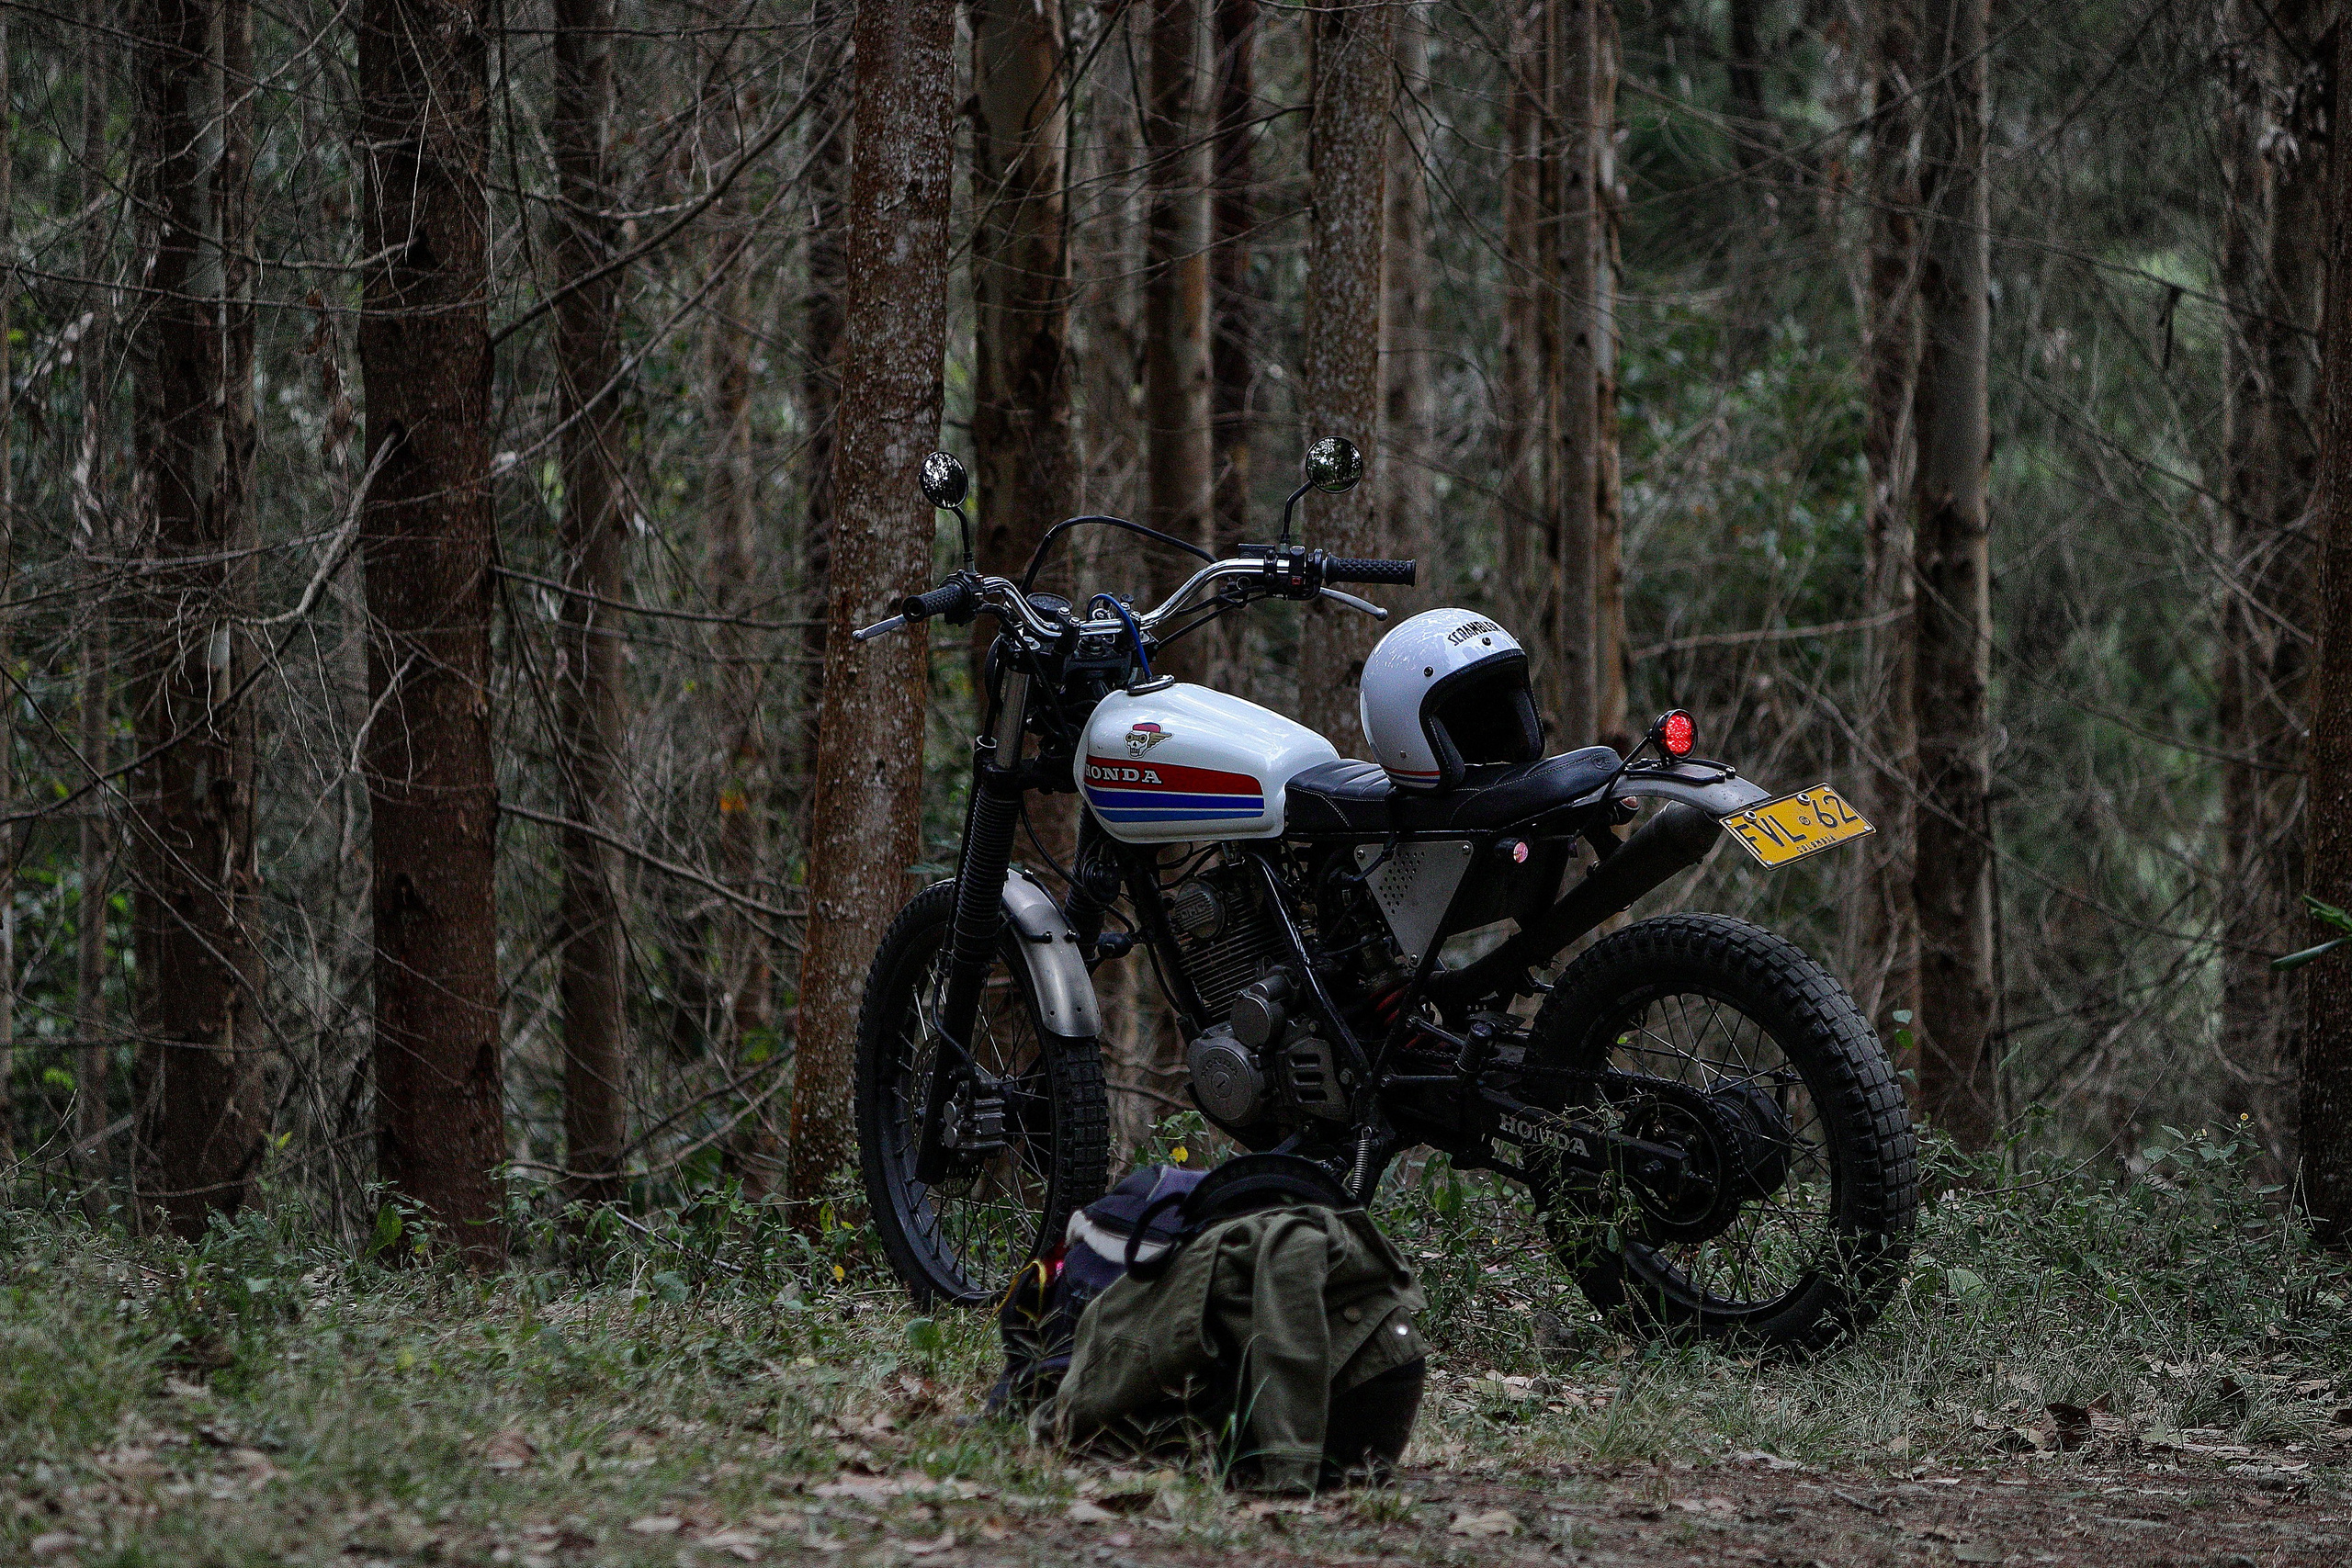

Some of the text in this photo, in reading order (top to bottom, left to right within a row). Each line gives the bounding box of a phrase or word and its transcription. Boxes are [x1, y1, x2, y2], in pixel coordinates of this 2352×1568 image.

[1447, 621, 1500, 647] SCRAMBLER
[1085, 762, 1162, 784] HONDA
[1733, 795, 1859, 855] FVL 62
[1796, 834, 1837, 853] COLOMBIA
